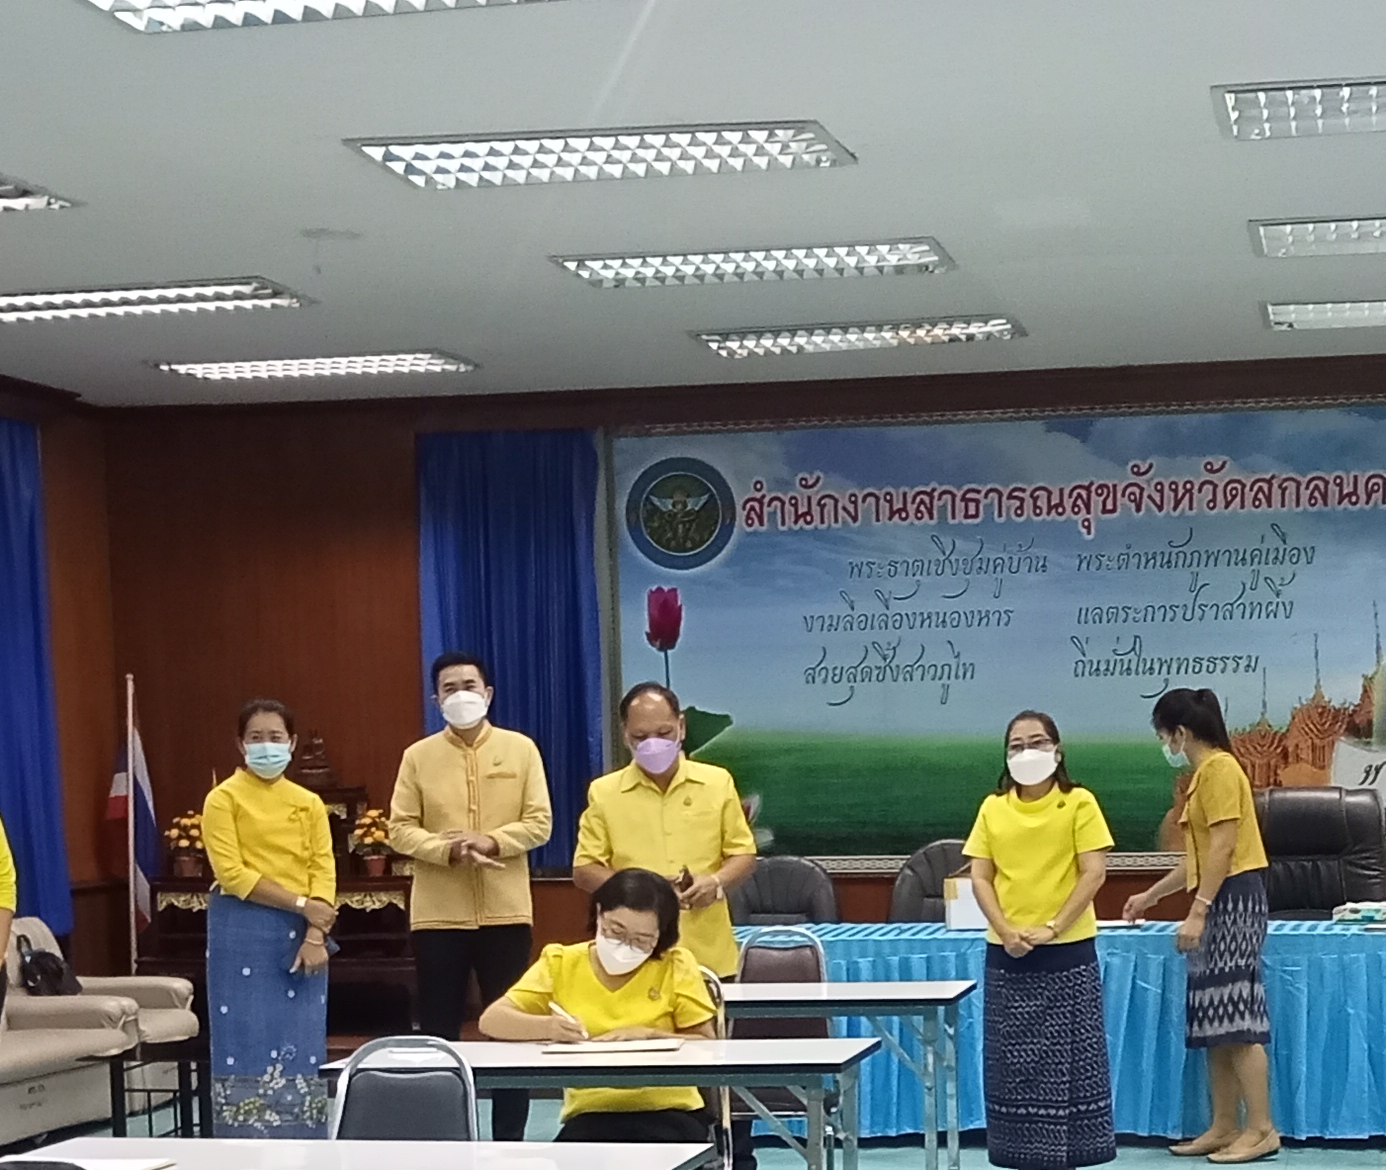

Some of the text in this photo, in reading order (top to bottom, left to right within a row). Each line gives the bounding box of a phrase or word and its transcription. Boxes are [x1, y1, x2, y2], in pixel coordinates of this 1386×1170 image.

[848, 523, 1316, 601] พระธาตุเชิงชุมคู่บ้าน พระตำหนักภูพานคู่เมือง
[803, 573, 1295, 633] งามลือเลื่องหนองหาร แลตระการปราสาทผึ้ง
[803, 635, 1260, 707] สวยสุดซึ้งสาวภูไท ถิ่นมั่นในพุทธธรรม
